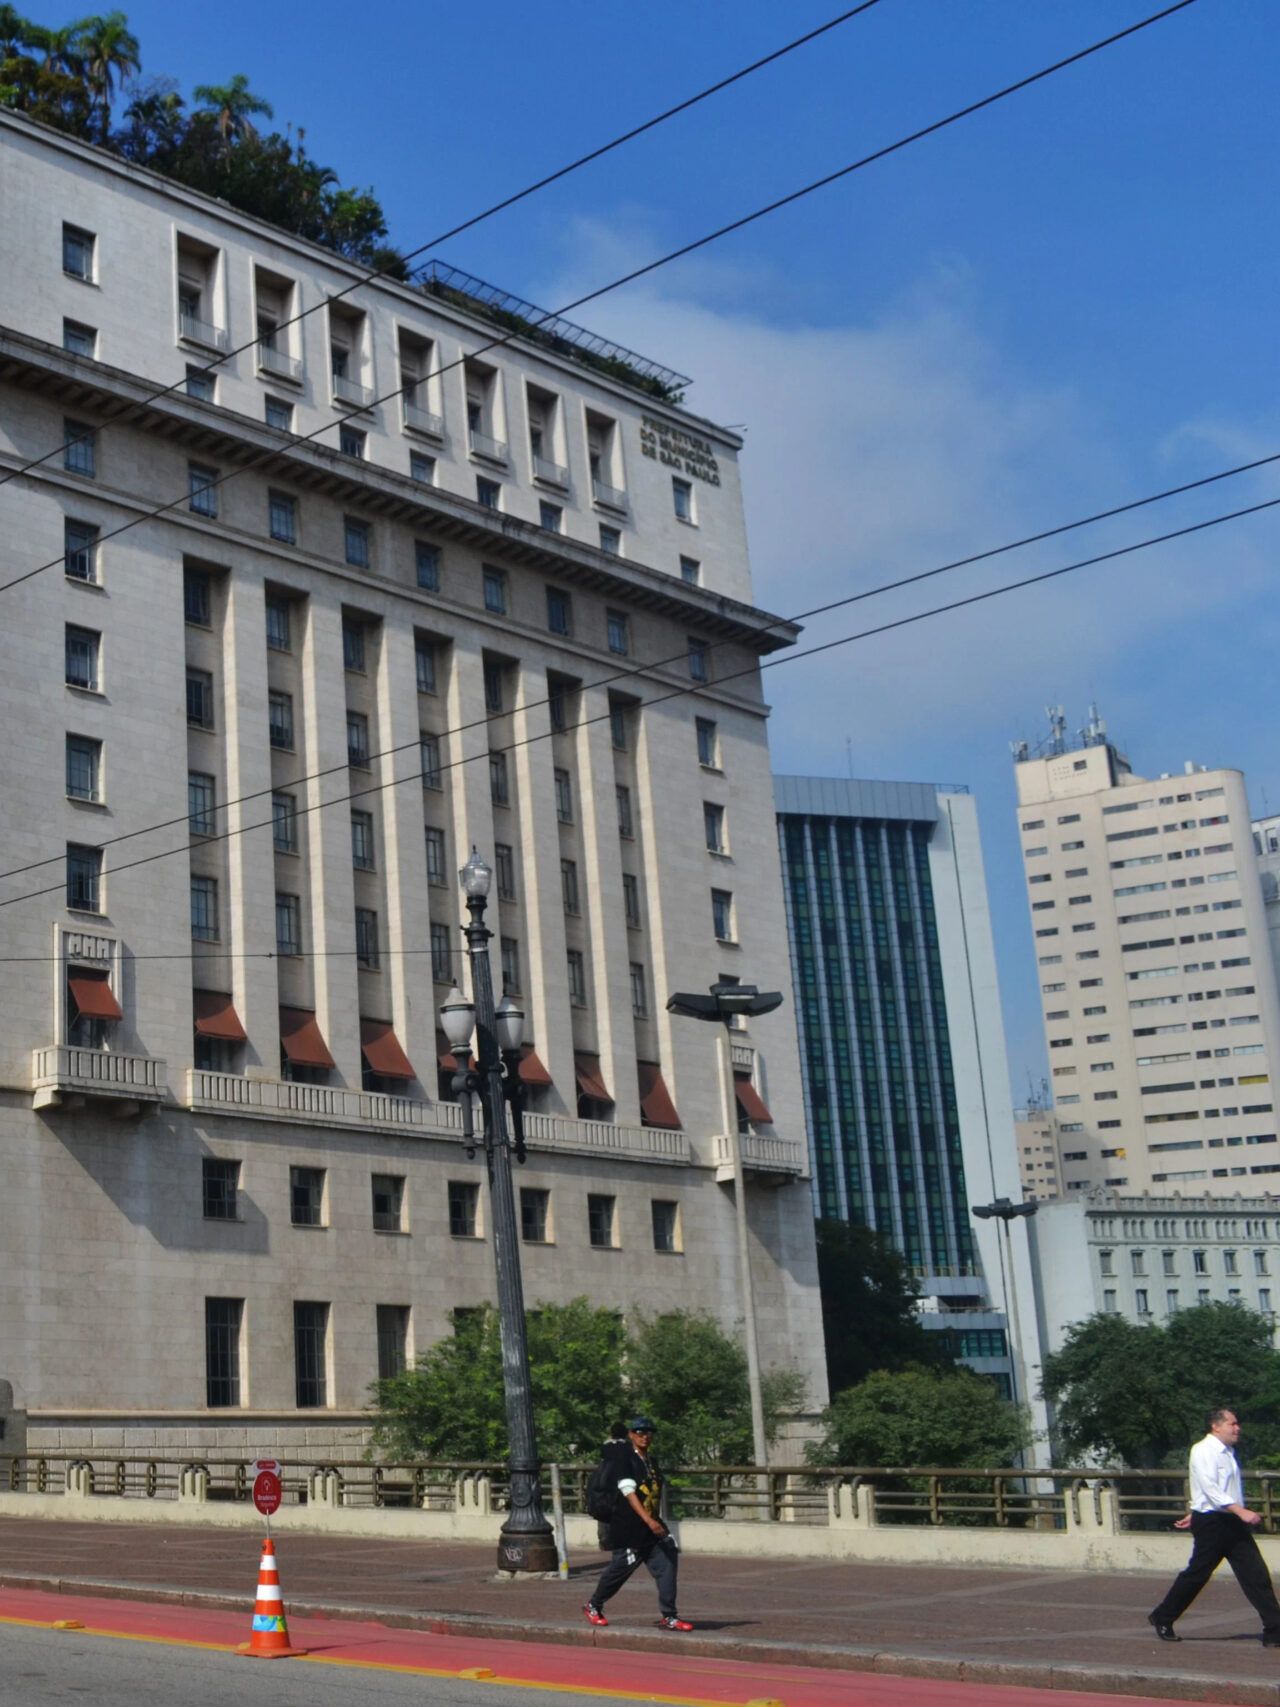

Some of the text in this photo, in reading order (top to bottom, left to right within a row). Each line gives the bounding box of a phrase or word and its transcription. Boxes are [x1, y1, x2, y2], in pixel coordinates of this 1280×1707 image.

[640, 428, 656, 444] DO
[642, 415, 712, 456] PREFEITURA
[641, 443, 656, 460] DE
[685, 461, 720, 486] PAULO
